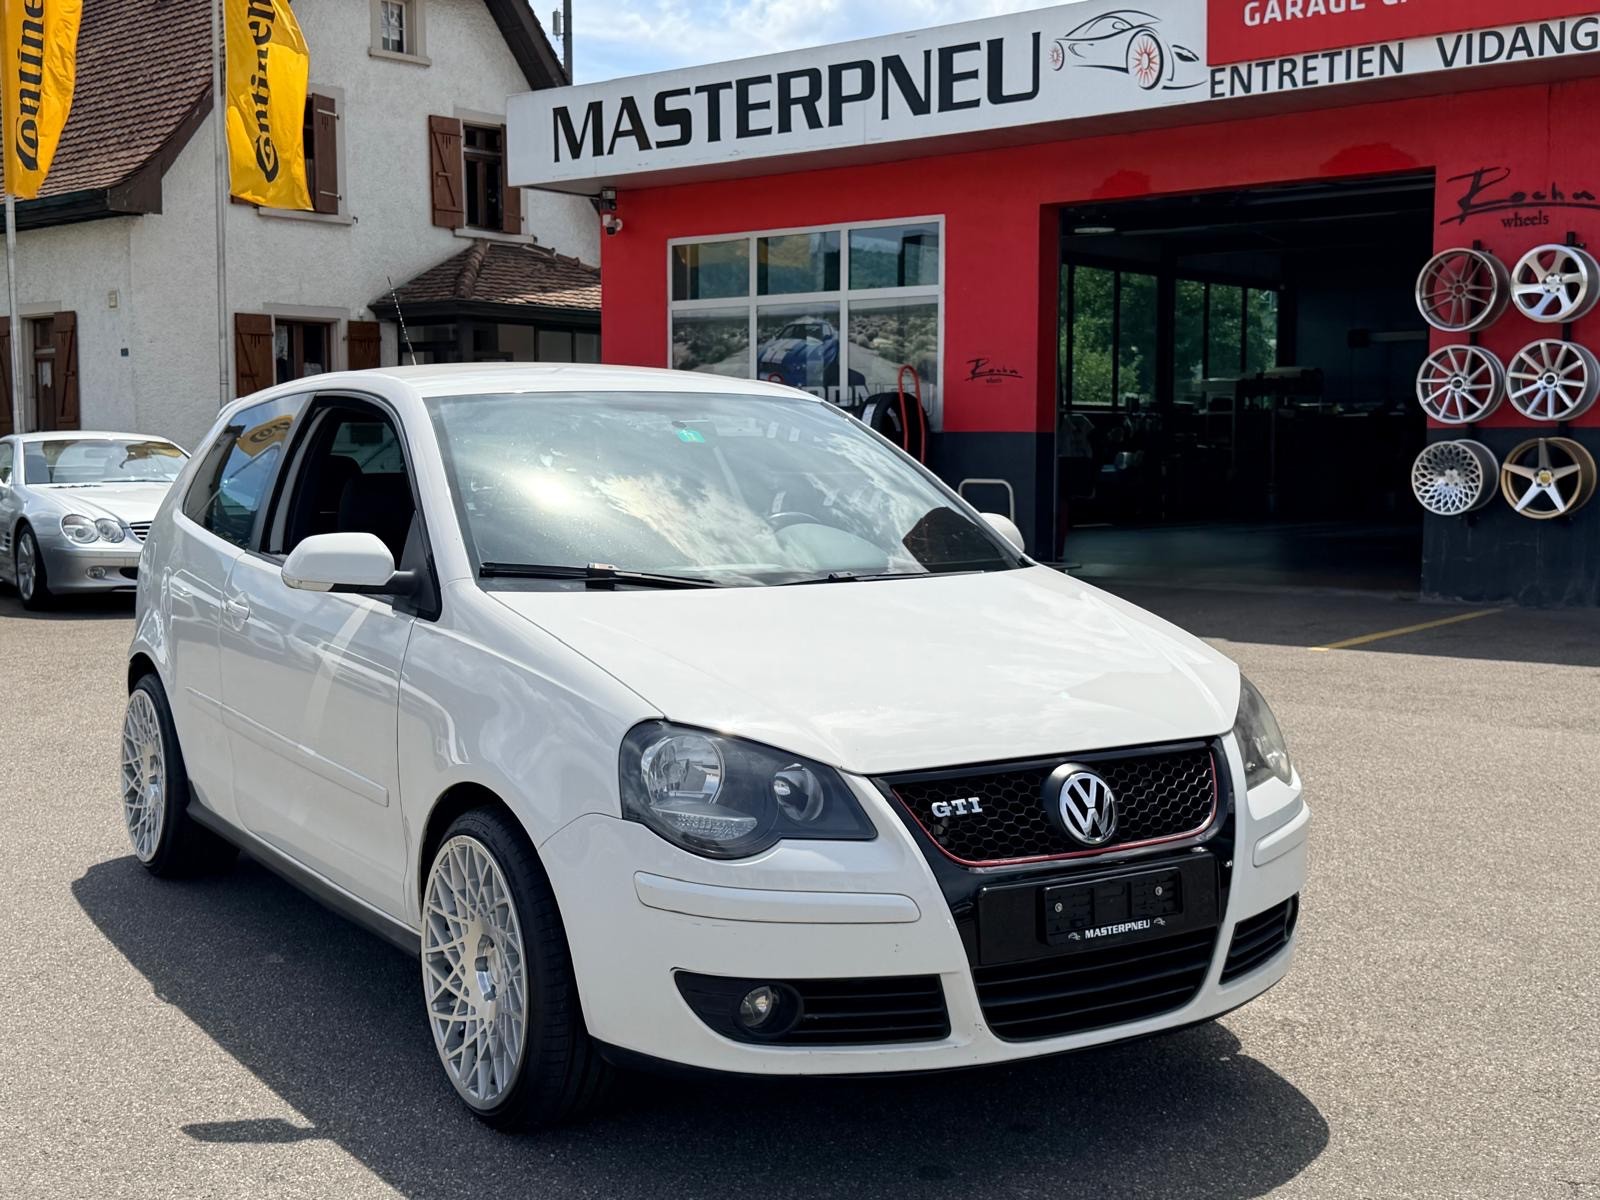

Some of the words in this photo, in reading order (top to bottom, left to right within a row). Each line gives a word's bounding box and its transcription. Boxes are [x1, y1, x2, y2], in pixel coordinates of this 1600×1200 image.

[1210, 42, 1404, 99] ENTRETIEN
[1435, 17, 1599, 68] VIDANG
[552, 32, 1041, 163] MASTERPNEU
[1501, 210, 1549, 228] wheels
[931, 796, 983, 818] GTI
[1085, 919, 1151, 939] MASTERPNEU
